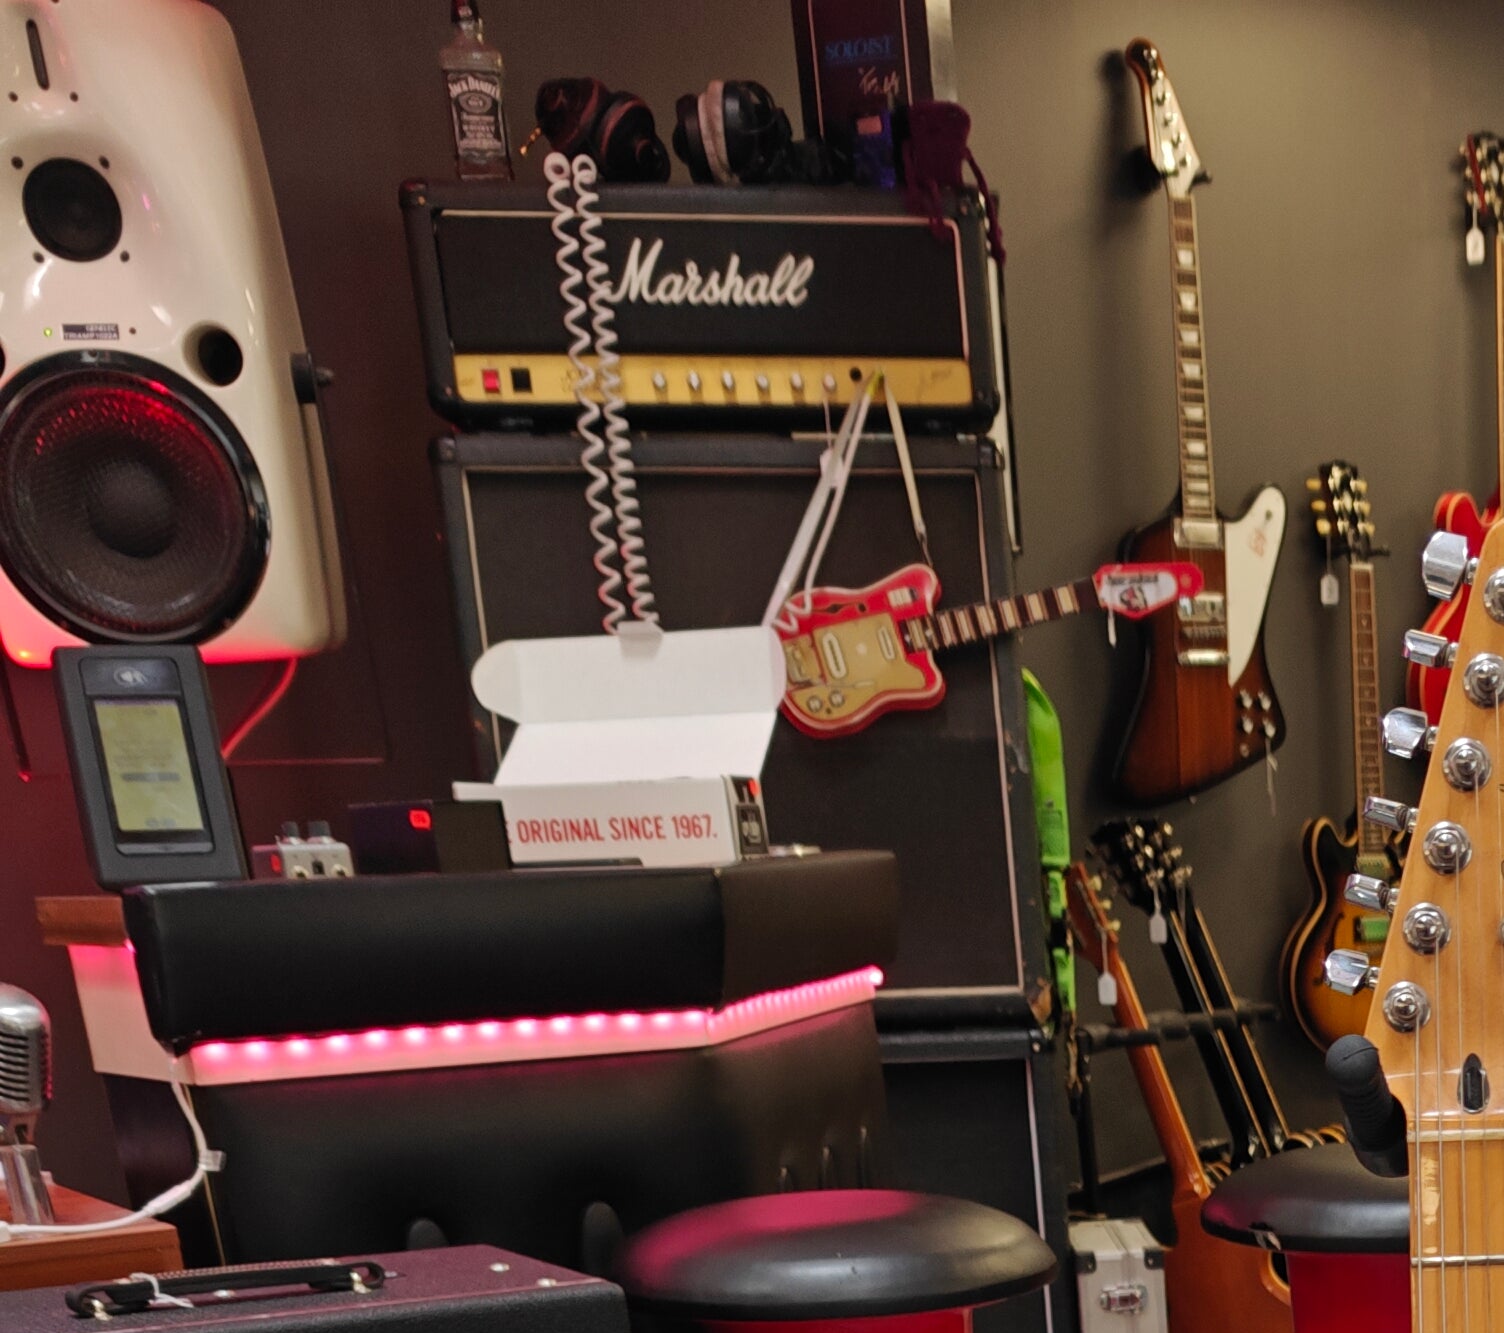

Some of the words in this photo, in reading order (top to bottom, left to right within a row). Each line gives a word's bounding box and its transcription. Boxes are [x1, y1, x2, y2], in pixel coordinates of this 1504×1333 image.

[605, 236, 814, 307] Marshall
[516, 817, 605, 845] ORIGINAL
[608, 815, 667, 841] SINCE
[671, 813, 718, 839] 1967.
